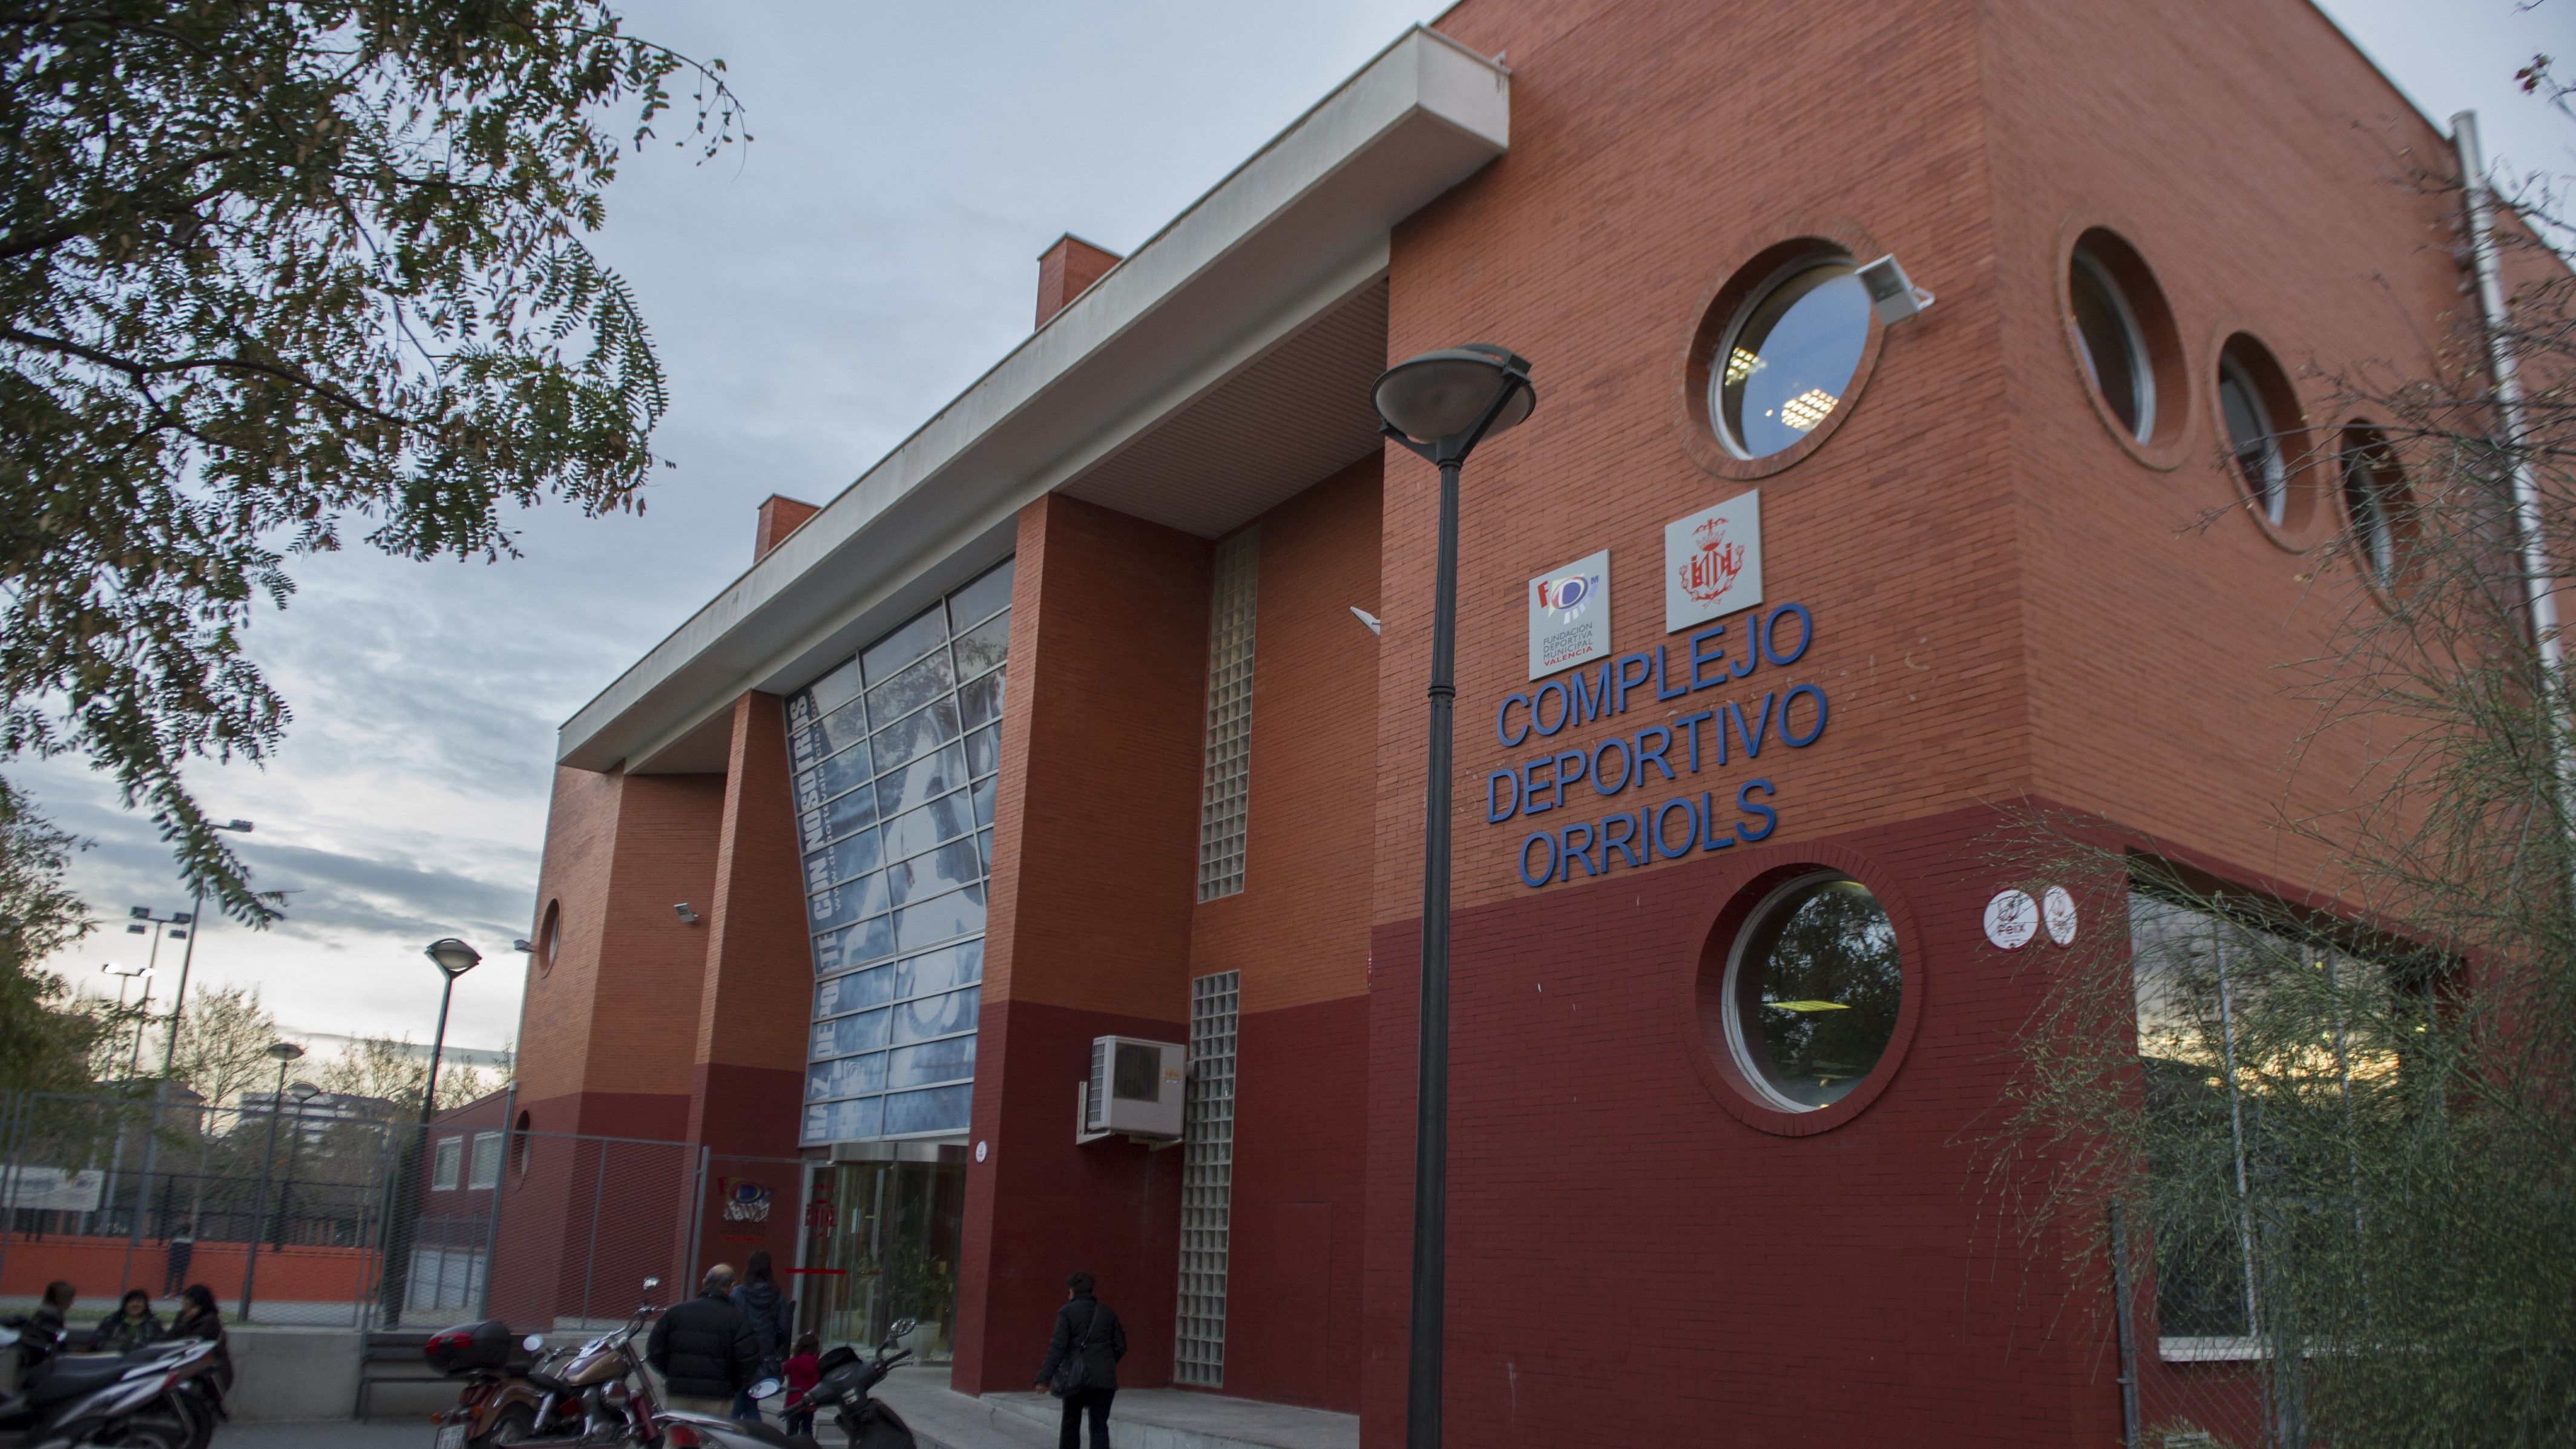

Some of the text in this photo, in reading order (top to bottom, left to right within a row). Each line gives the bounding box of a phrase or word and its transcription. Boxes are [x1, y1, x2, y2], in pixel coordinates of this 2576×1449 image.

[1543, 622, 1592, 645] FUNDACIÓN
[1543, 631, 1592, 652] DEPORTIVA
[1543, 639, 1593, 660] MUNICIPAL
[1544, 646, 1592, 666] VALENCIA
[1496, 602, 1812, 746] COMPLEJO
[790, 696, 824, 852] NOSOTROS
[1487, 683, 1827, 823] DEPORTIVO
[810, 694, 841, 912] www.deportevalecia.com
[1519, 778, 1777, 887] ORRIOLS
[809, 857, 832, 920] CON
[807, 1075, 830, 1139] HAZ
